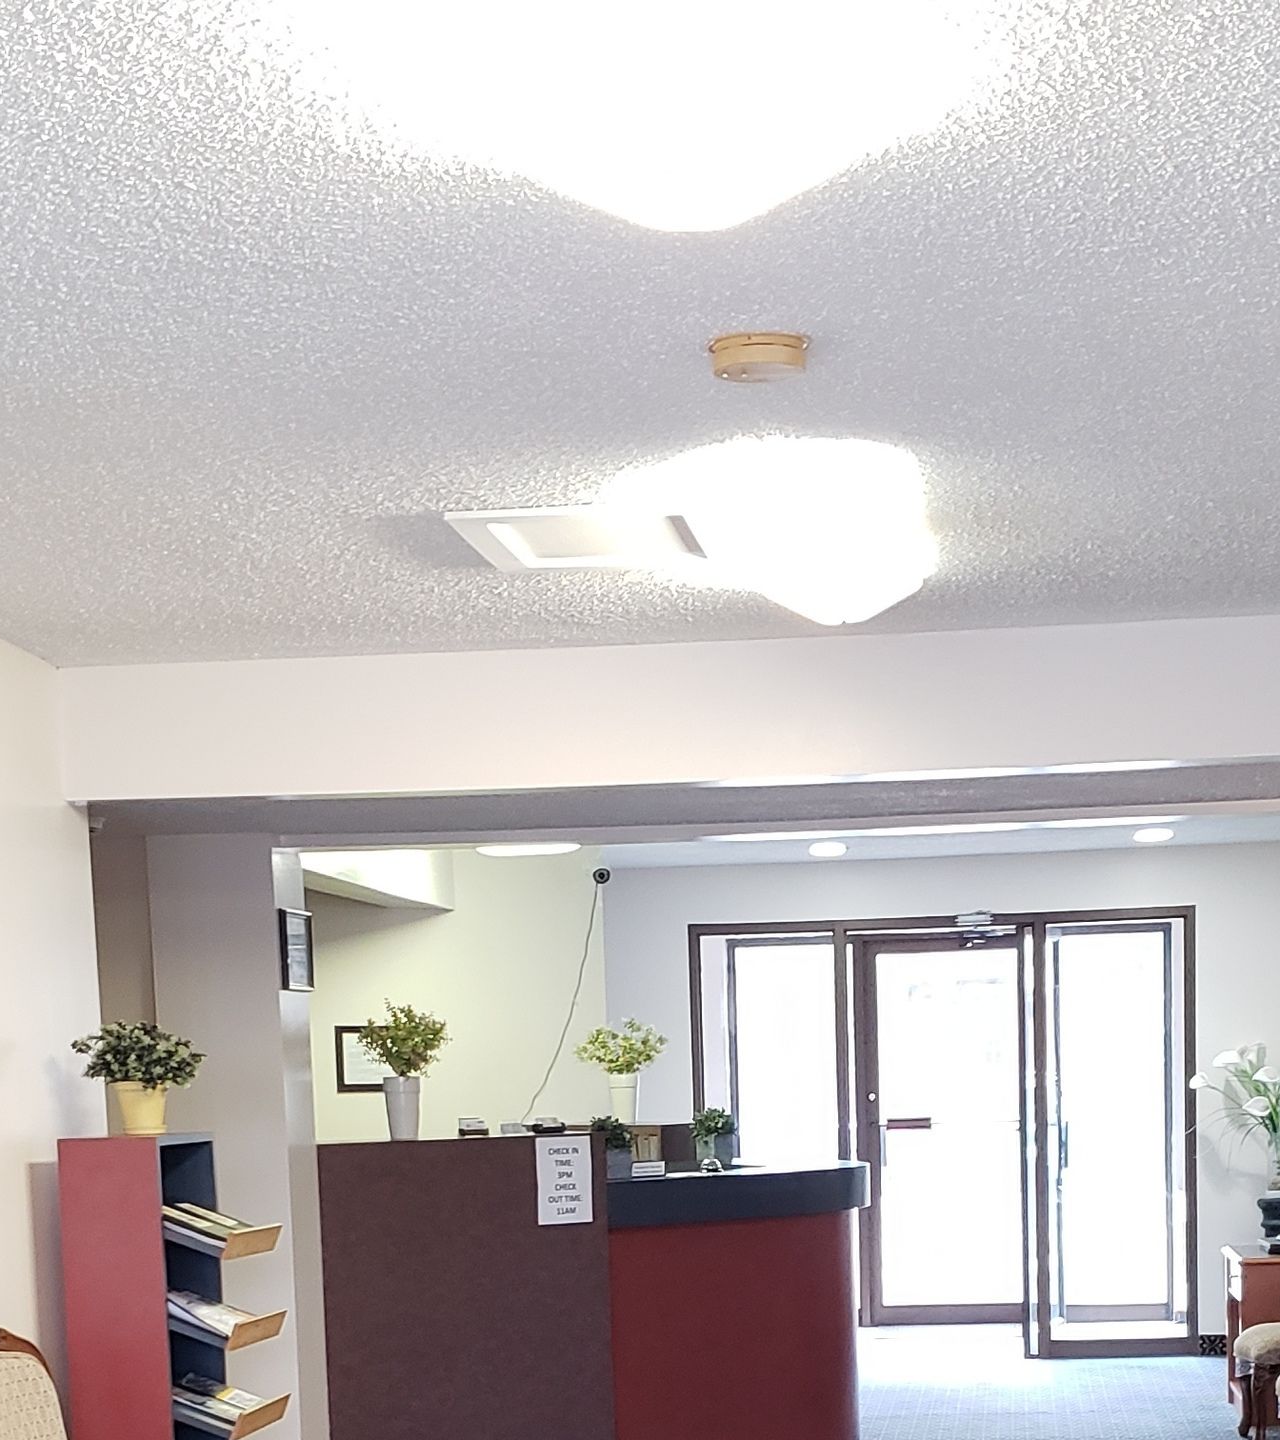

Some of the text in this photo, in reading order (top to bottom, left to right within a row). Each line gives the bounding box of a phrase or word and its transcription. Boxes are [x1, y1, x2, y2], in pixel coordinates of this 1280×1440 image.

[548, 1147, 570, 1156] CHECK
[555, 1183, 576, 1191] CHECK
[548, 1195, 563, 1203] OUT
